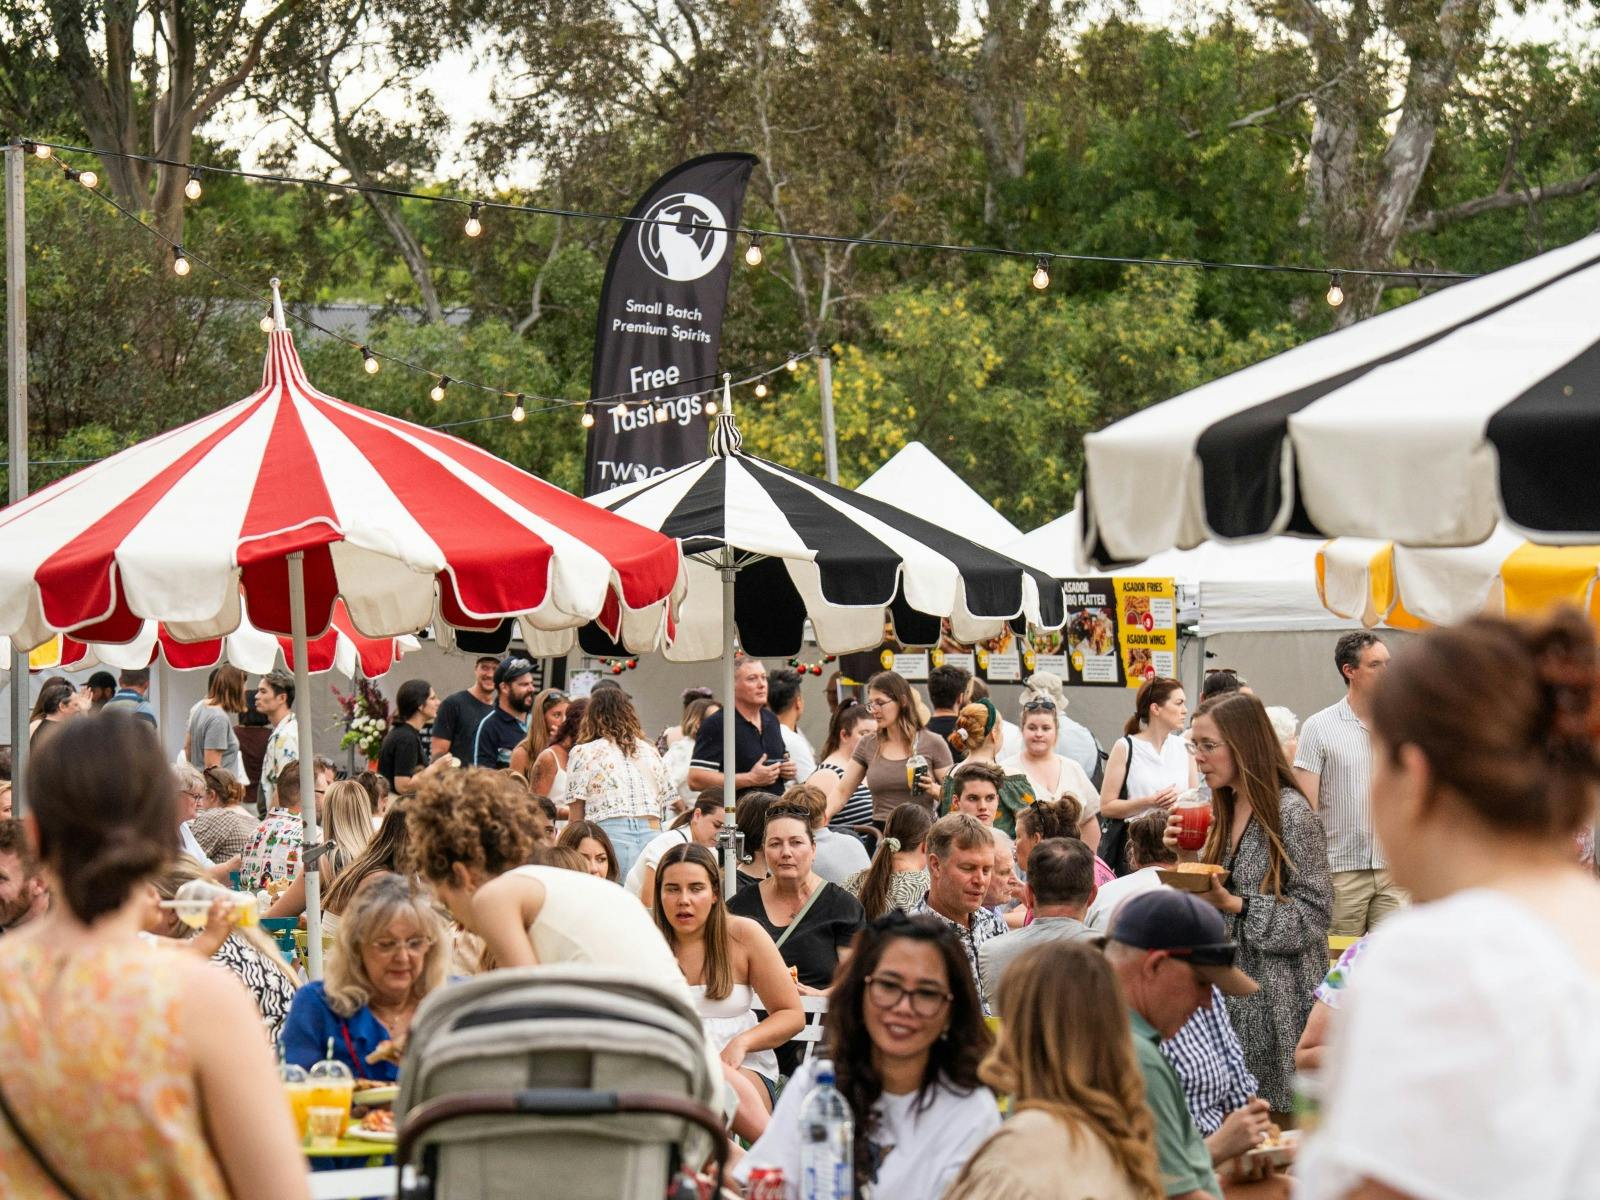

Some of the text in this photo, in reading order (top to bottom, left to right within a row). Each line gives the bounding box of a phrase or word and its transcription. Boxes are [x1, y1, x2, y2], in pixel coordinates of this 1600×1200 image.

[626, 299, 702, 321] Small Batch
[612, 318, 711, 344] Premium Spirits
[630, 365, 680, 394] Free
[607, 395, 702, 435] Tastngs
[1063, 581, 1089, 593] ASADOR
[1123, 582, 1163, 592] ASADOR FRIES
[1077, 593, 1107, 606] PLATTER
[1127, 634, 1148, 644] ASADOR
